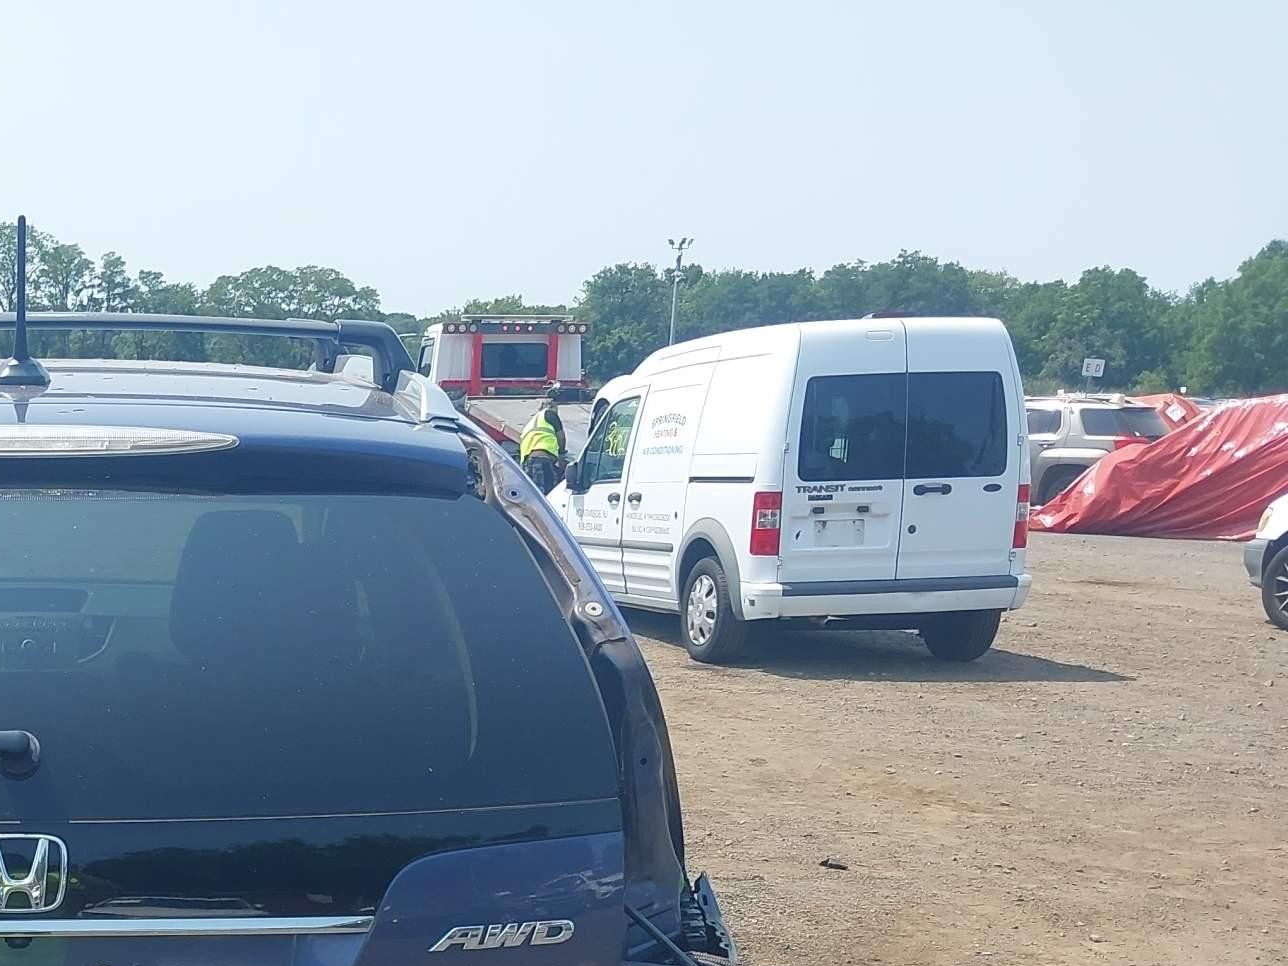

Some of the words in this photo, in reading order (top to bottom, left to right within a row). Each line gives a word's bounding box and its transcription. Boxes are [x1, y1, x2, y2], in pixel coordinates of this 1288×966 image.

[1085, 362, 1092, 373] E
[1094, 363, 1101, 373] D
[795, 484, 846, 493] TRANSIT
[428, 919, 575, 952] AWD
